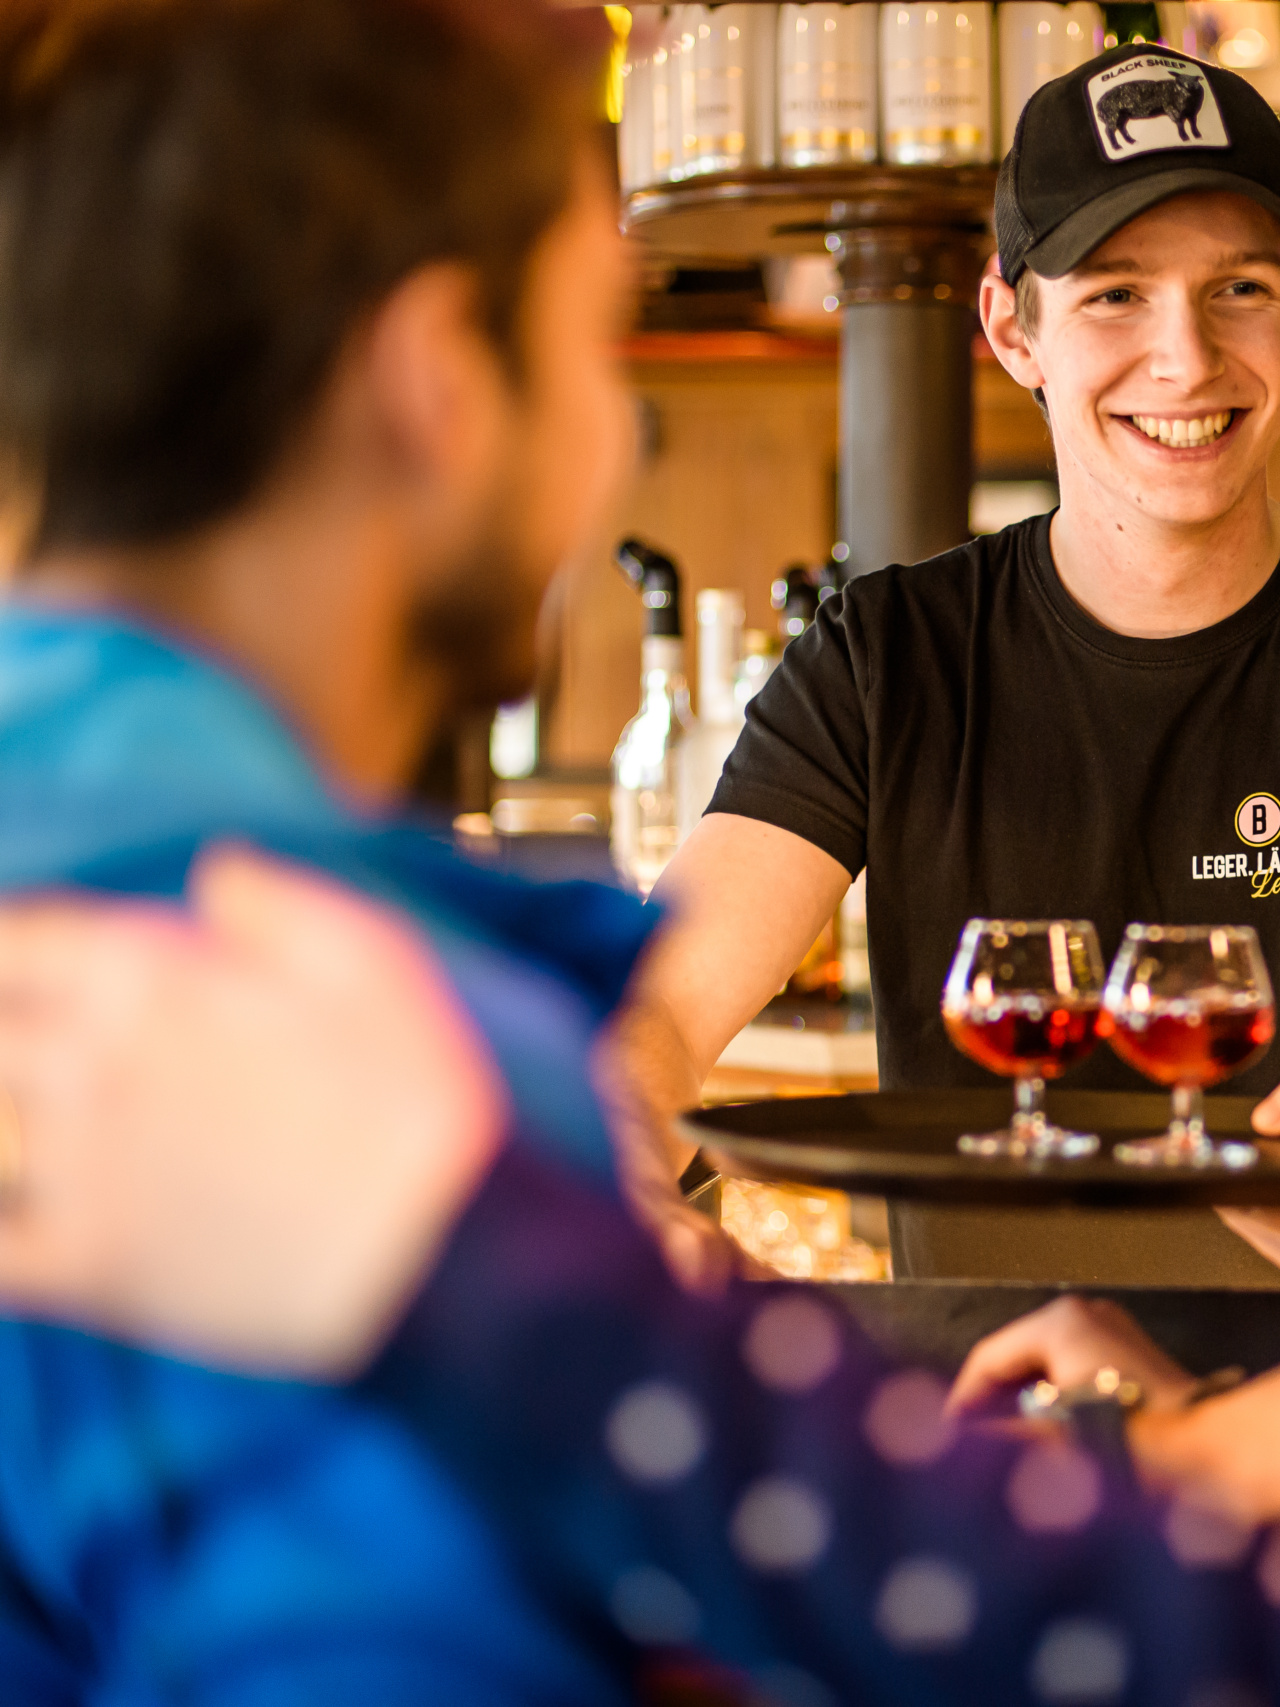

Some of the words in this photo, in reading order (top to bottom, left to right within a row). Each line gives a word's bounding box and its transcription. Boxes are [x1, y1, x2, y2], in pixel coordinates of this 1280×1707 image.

[1101, 60, 1143, 82] BLACK
[1146, 59, 1187, 69] SHEEP
[1252, 804, 1267, 835] B
[1192, 853, 1254, 880] LEGER.
